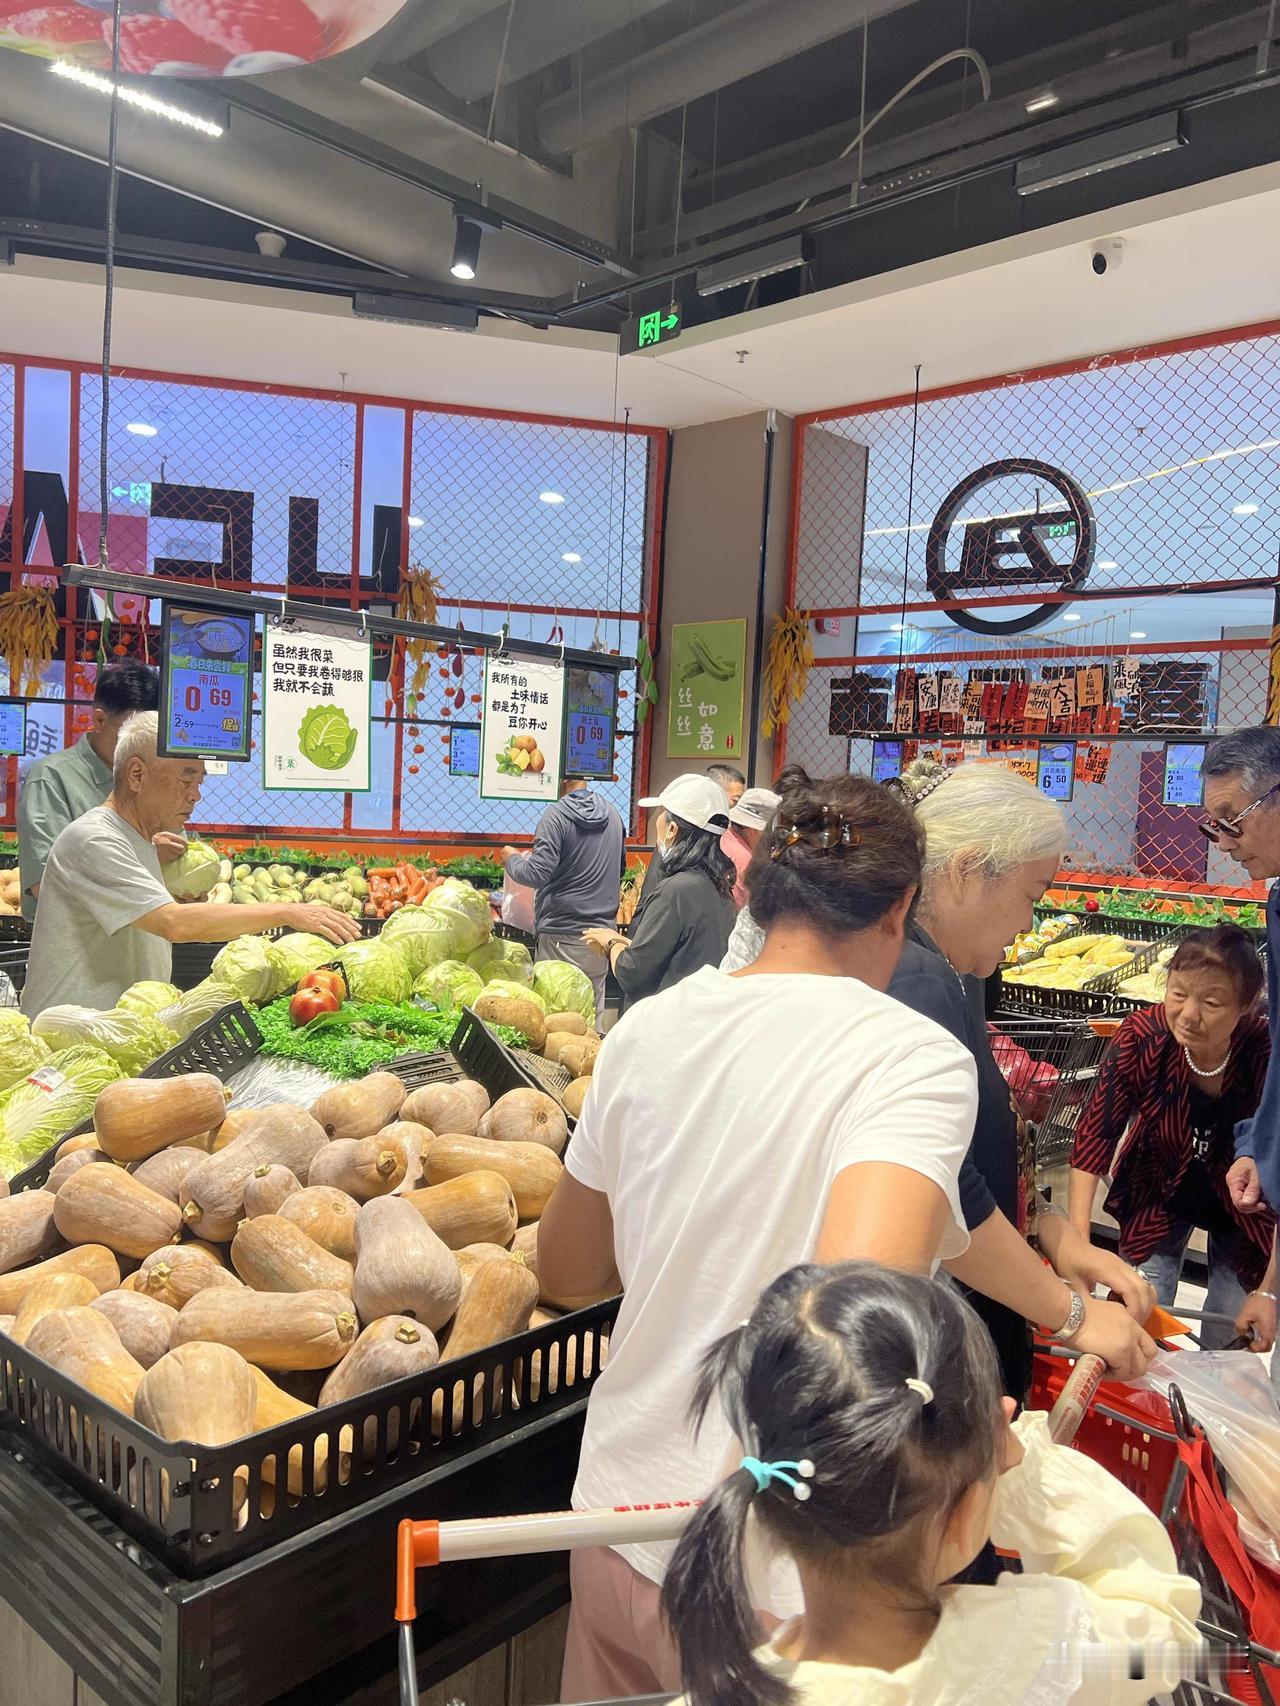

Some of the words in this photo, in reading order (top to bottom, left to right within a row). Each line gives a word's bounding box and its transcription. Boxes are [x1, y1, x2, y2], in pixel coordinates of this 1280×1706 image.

[272, 643, 334, 664] 虽然我很菜
[199, 674, 219, 686] 南瓜
[272, 662, 364, 682] 但只要我卷得够狠
[491, 671, 527, 688] 我所有的
[273, 678, 335, 697] 我就不会蔬
[510, 689, 549, 705] 土味情话
[1051, 682, 1073, 714] 大吉
[491, 699, 527, 715] 都是为了
[507, 715, 548, 731] 豆你开心
[697, 701, 718, 751] 如意
